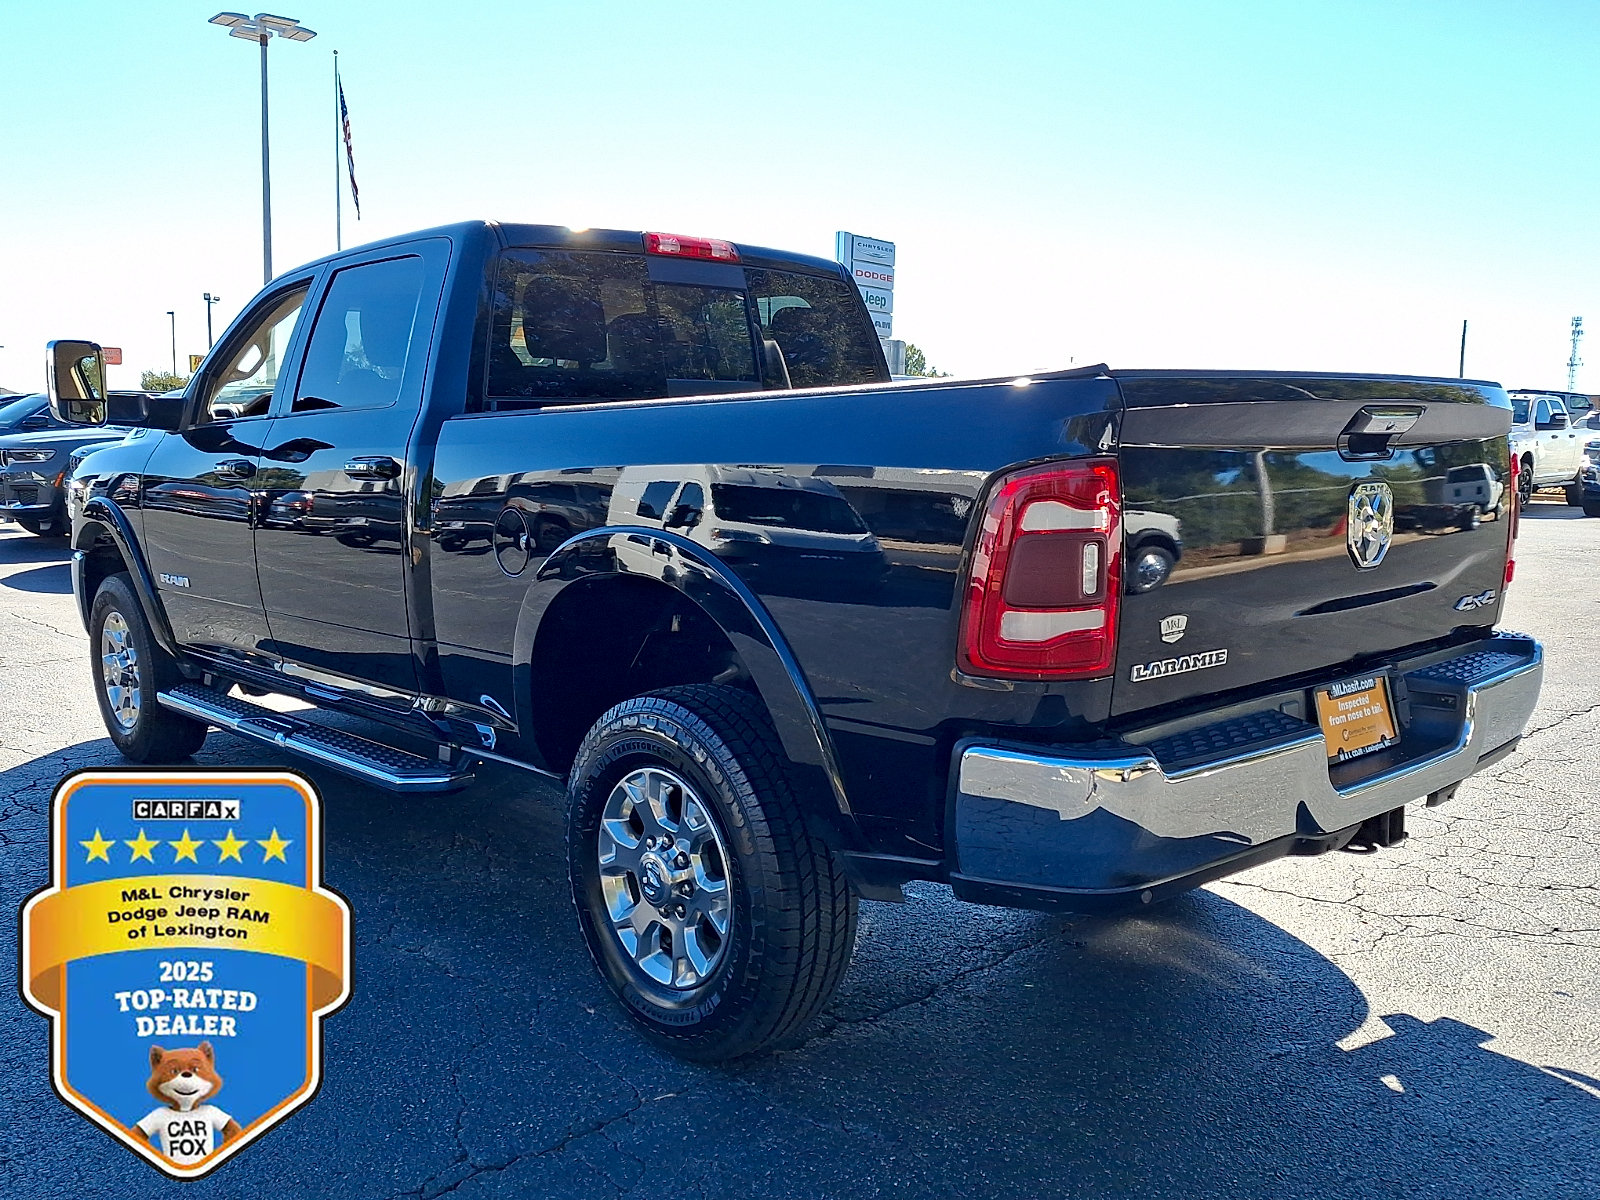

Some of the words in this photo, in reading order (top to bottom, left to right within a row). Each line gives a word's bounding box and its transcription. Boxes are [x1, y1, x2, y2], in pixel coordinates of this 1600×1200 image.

[857, 242, 893, 253] CHRYSLER
[856, 269, 893, 282] DODGE
[865, 291, 886, 308] Jeep
[874, 320, 891, 330] AM
[1361, 484, 1385, 493] RAM
[160, 573, 190, 588] RAM
[1165, 618, 1183, 632] M&L
[1131, 649, 1228, 683] LARAMIE
[1338, 694, 1370, 712] Inspected
[1328, 715, 1347, 726] from
[1347, 710, 1364, 721] nose
[1363, 707, 1371, 716] to
[611, 741, 662, 757] TRANSFORCE
